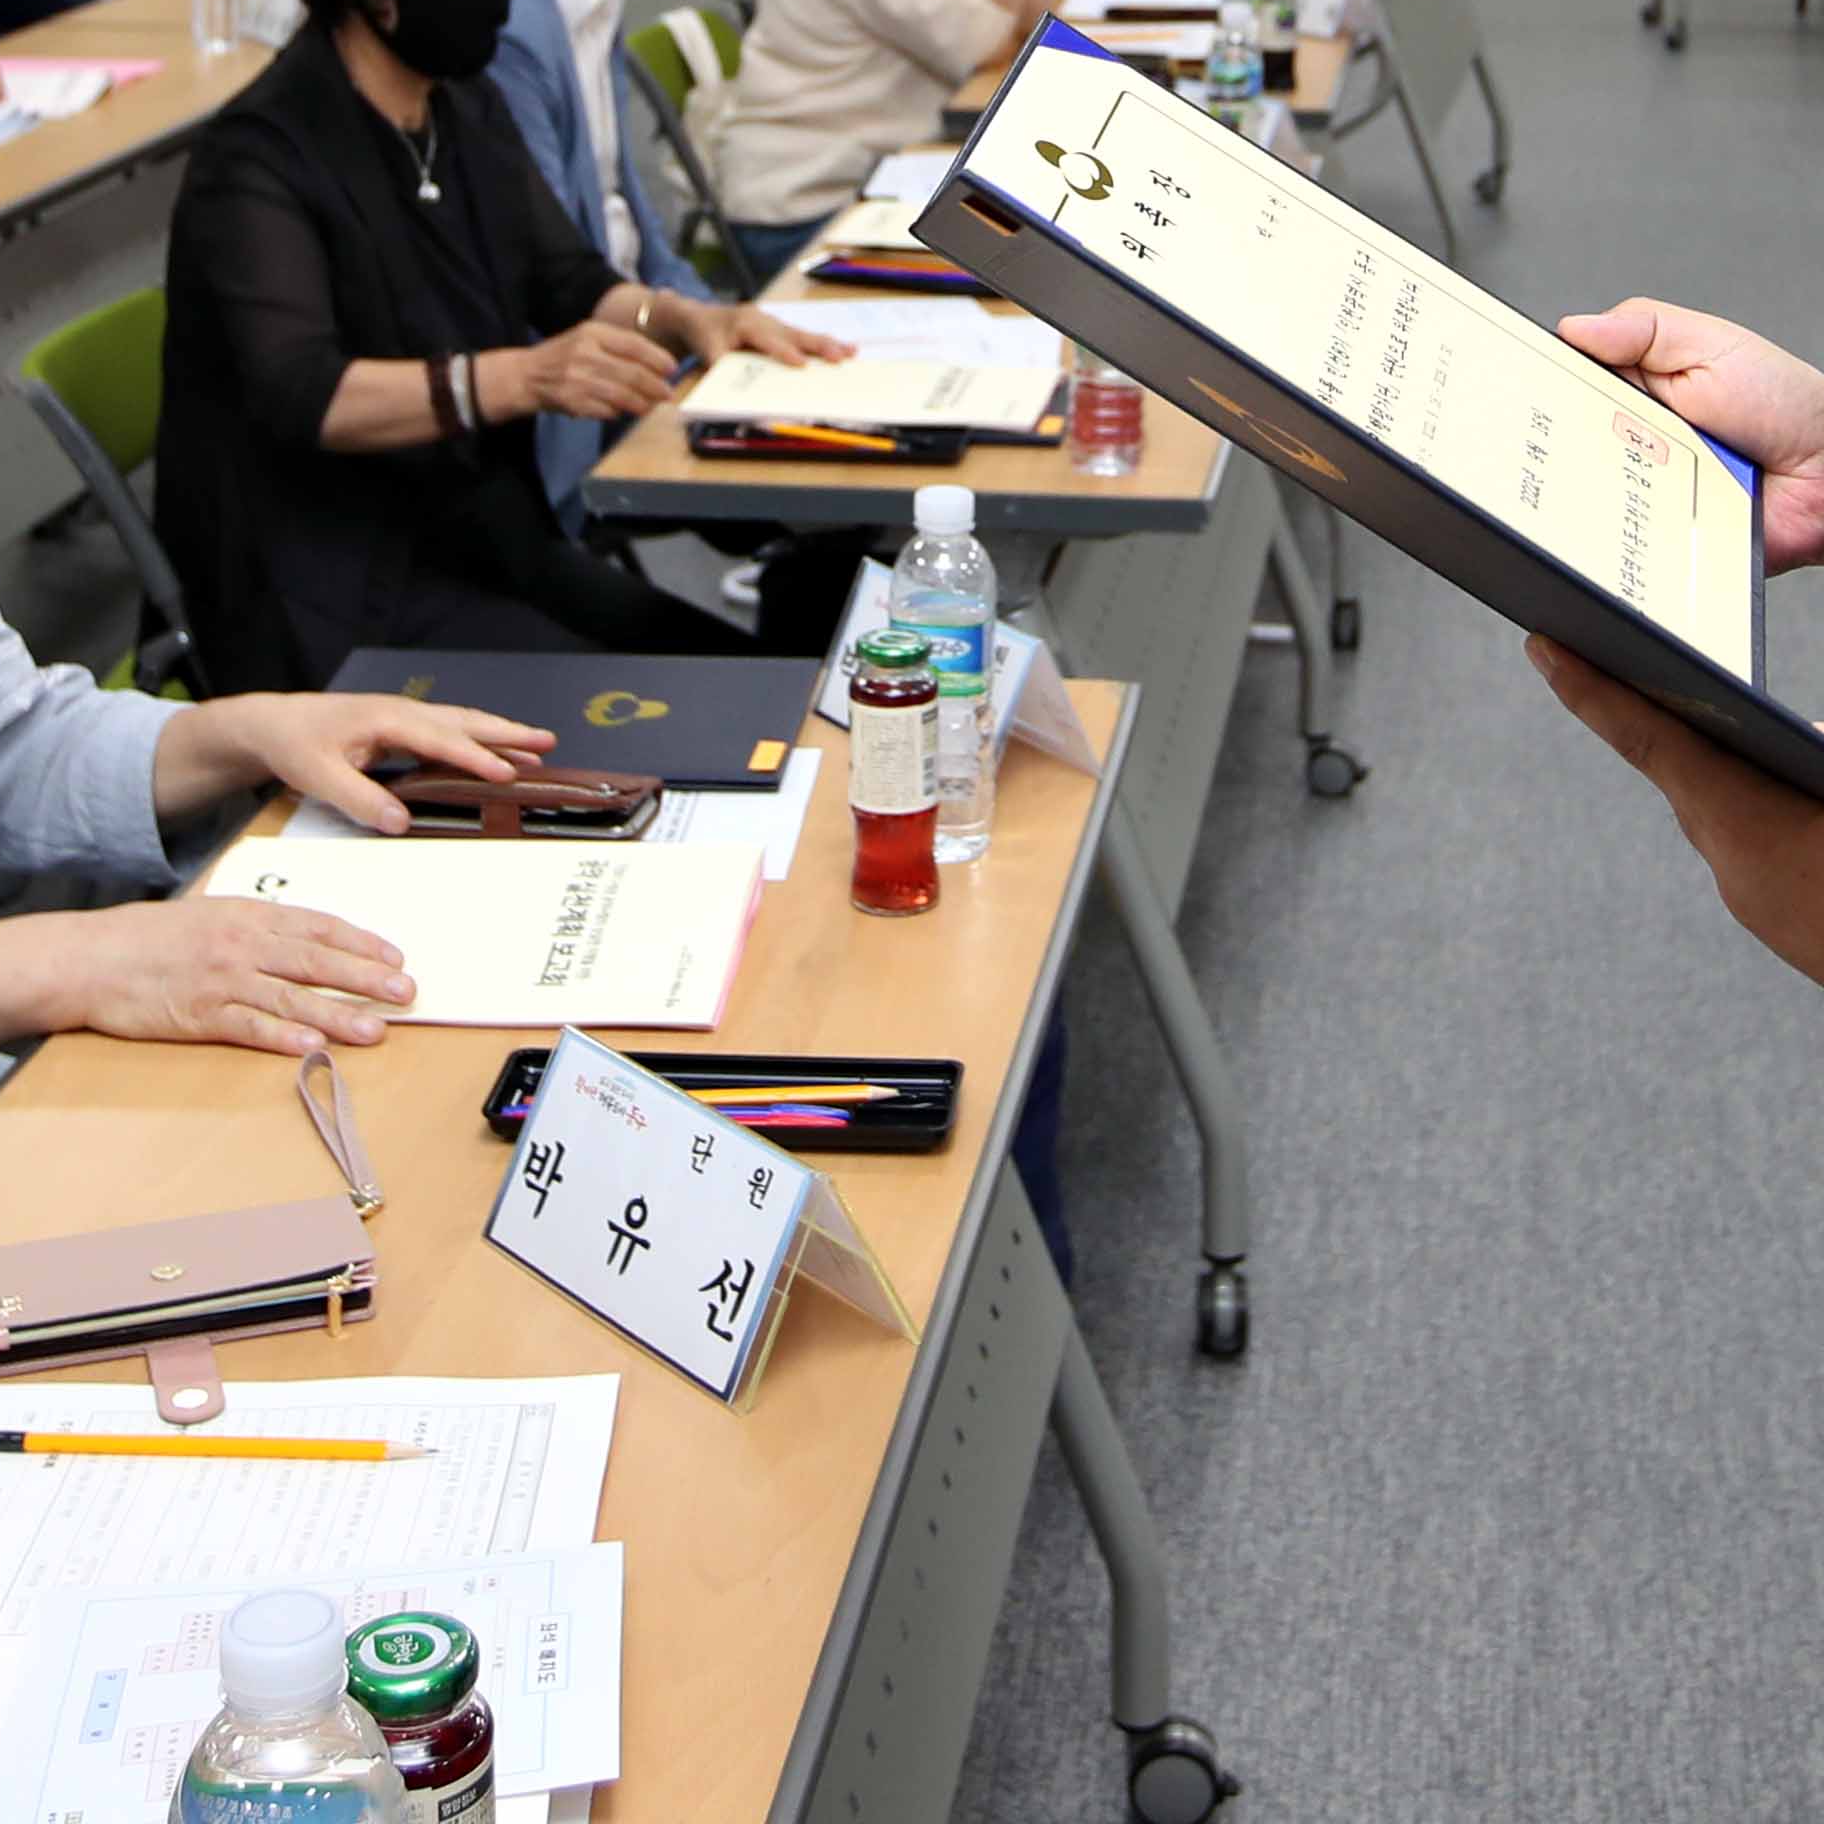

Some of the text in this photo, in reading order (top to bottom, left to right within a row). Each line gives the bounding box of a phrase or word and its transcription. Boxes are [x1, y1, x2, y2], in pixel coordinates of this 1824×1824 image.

[1317, 376, 1345, 406] 하를
[1619, 490, 1651, 602] 천광역시동구청장
[392, 1632, 419, 1664] 자연은
